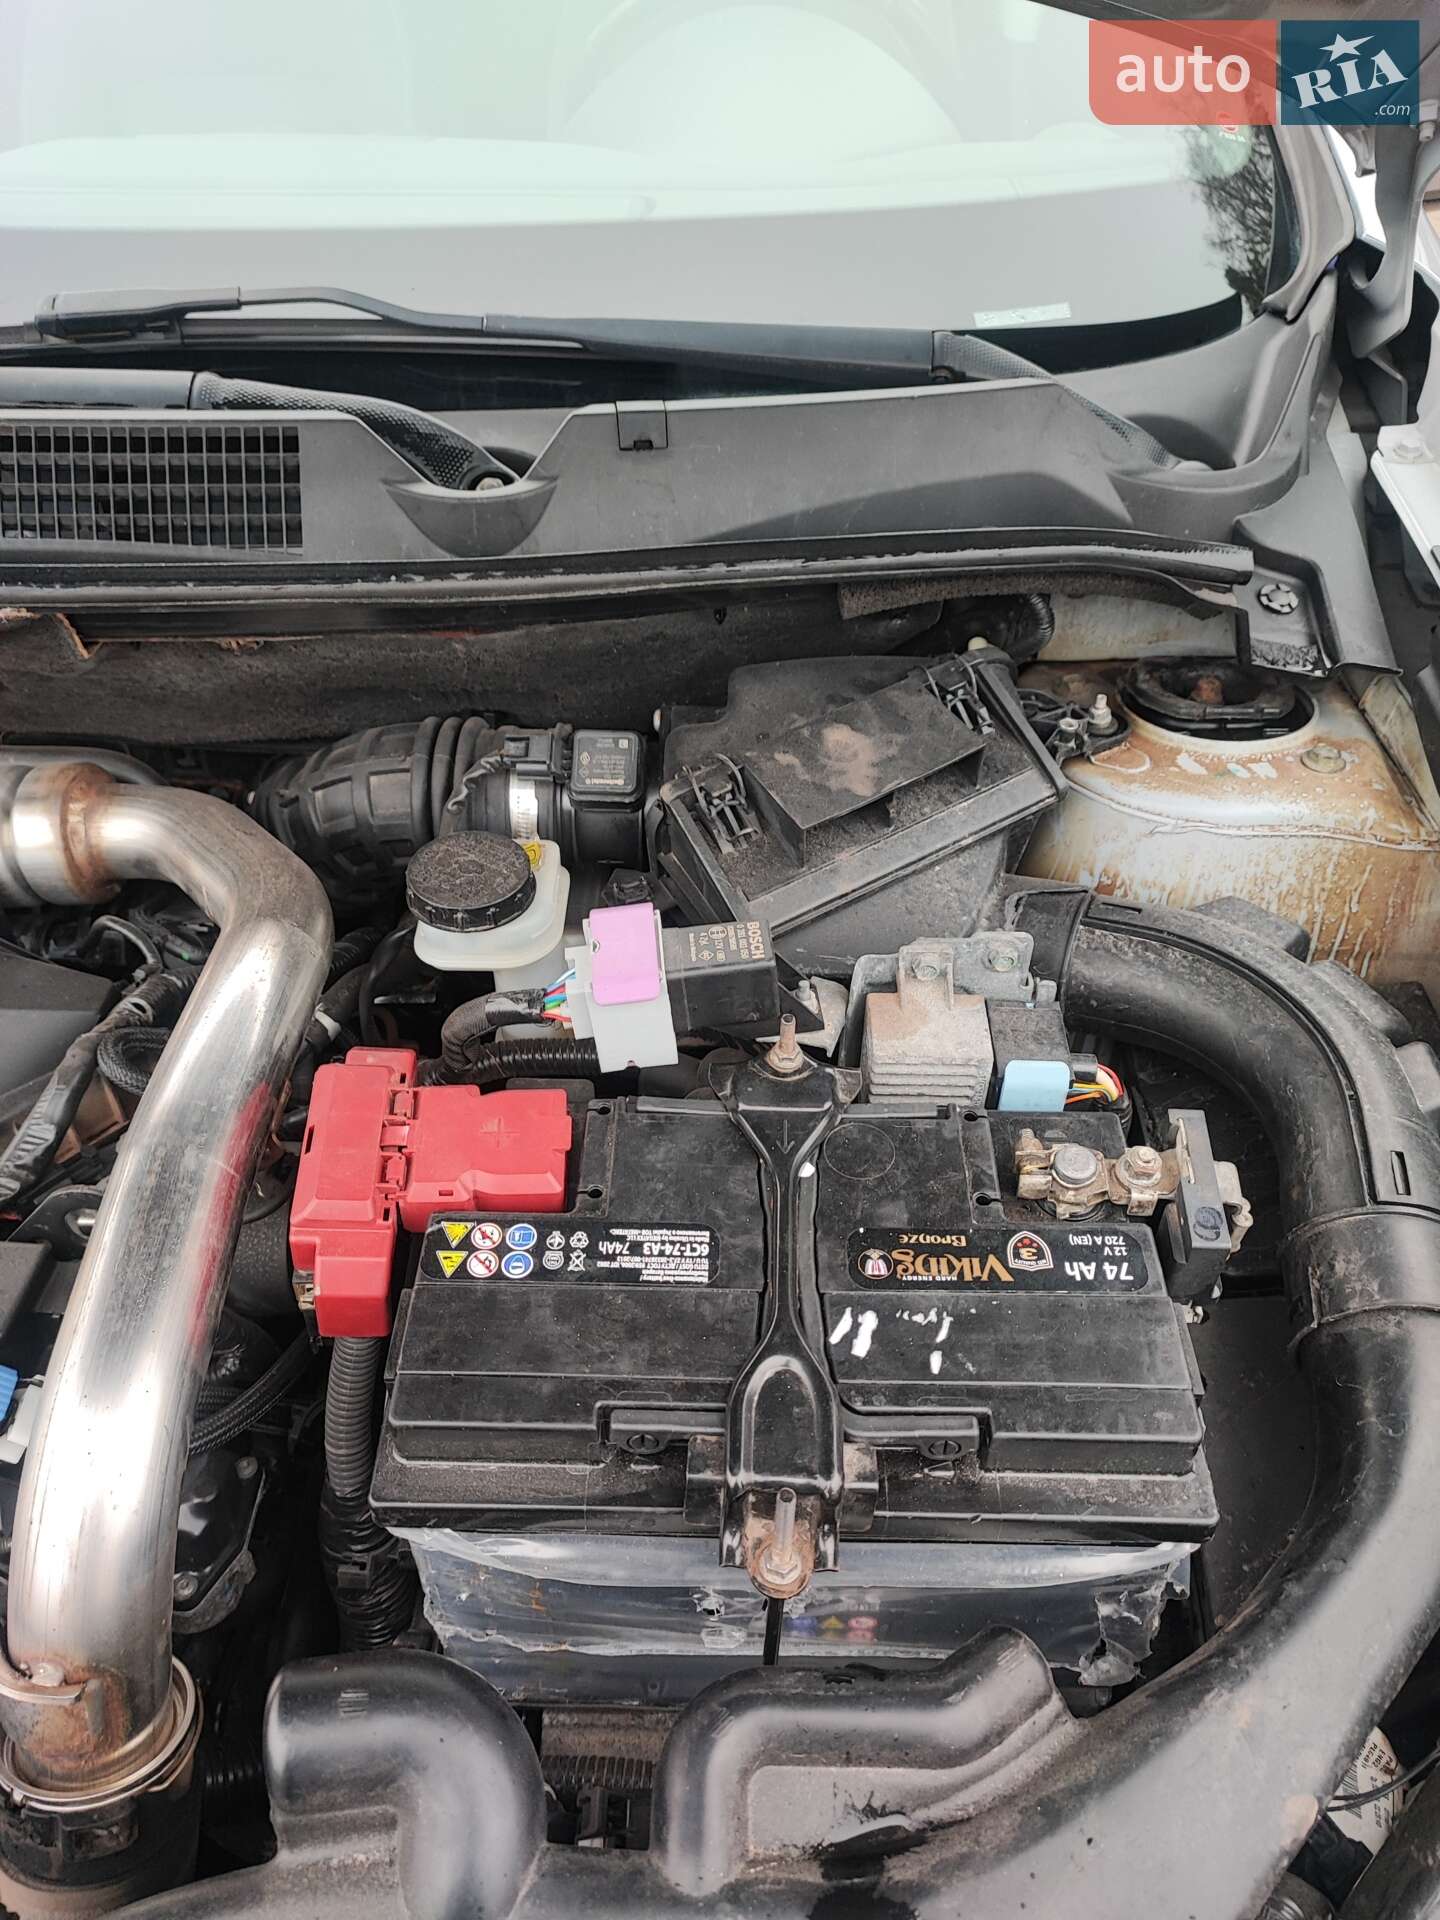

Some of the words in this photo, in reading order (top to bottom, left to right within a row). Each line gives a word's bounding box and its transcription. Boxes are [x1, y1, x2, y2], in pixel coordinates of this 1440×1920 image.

[746, 921, 765, 959] BOSCH
[1068, 1234, 1092, 1246] (EN)
[1094, 1236, 1102, 1245] A
[1105, 1236, 1125, 1245] 720
[599, 1241, 630, 1255] 74Ah
[1019, 1248, 1038, 1260] 3
[1104, 1246, 1112, 1256] V
[1113, 1246, 1128, 1256] 12
[1064, 1261, 1097, 1281] Ah
[1102, 1262, 1134, 1280] 74
